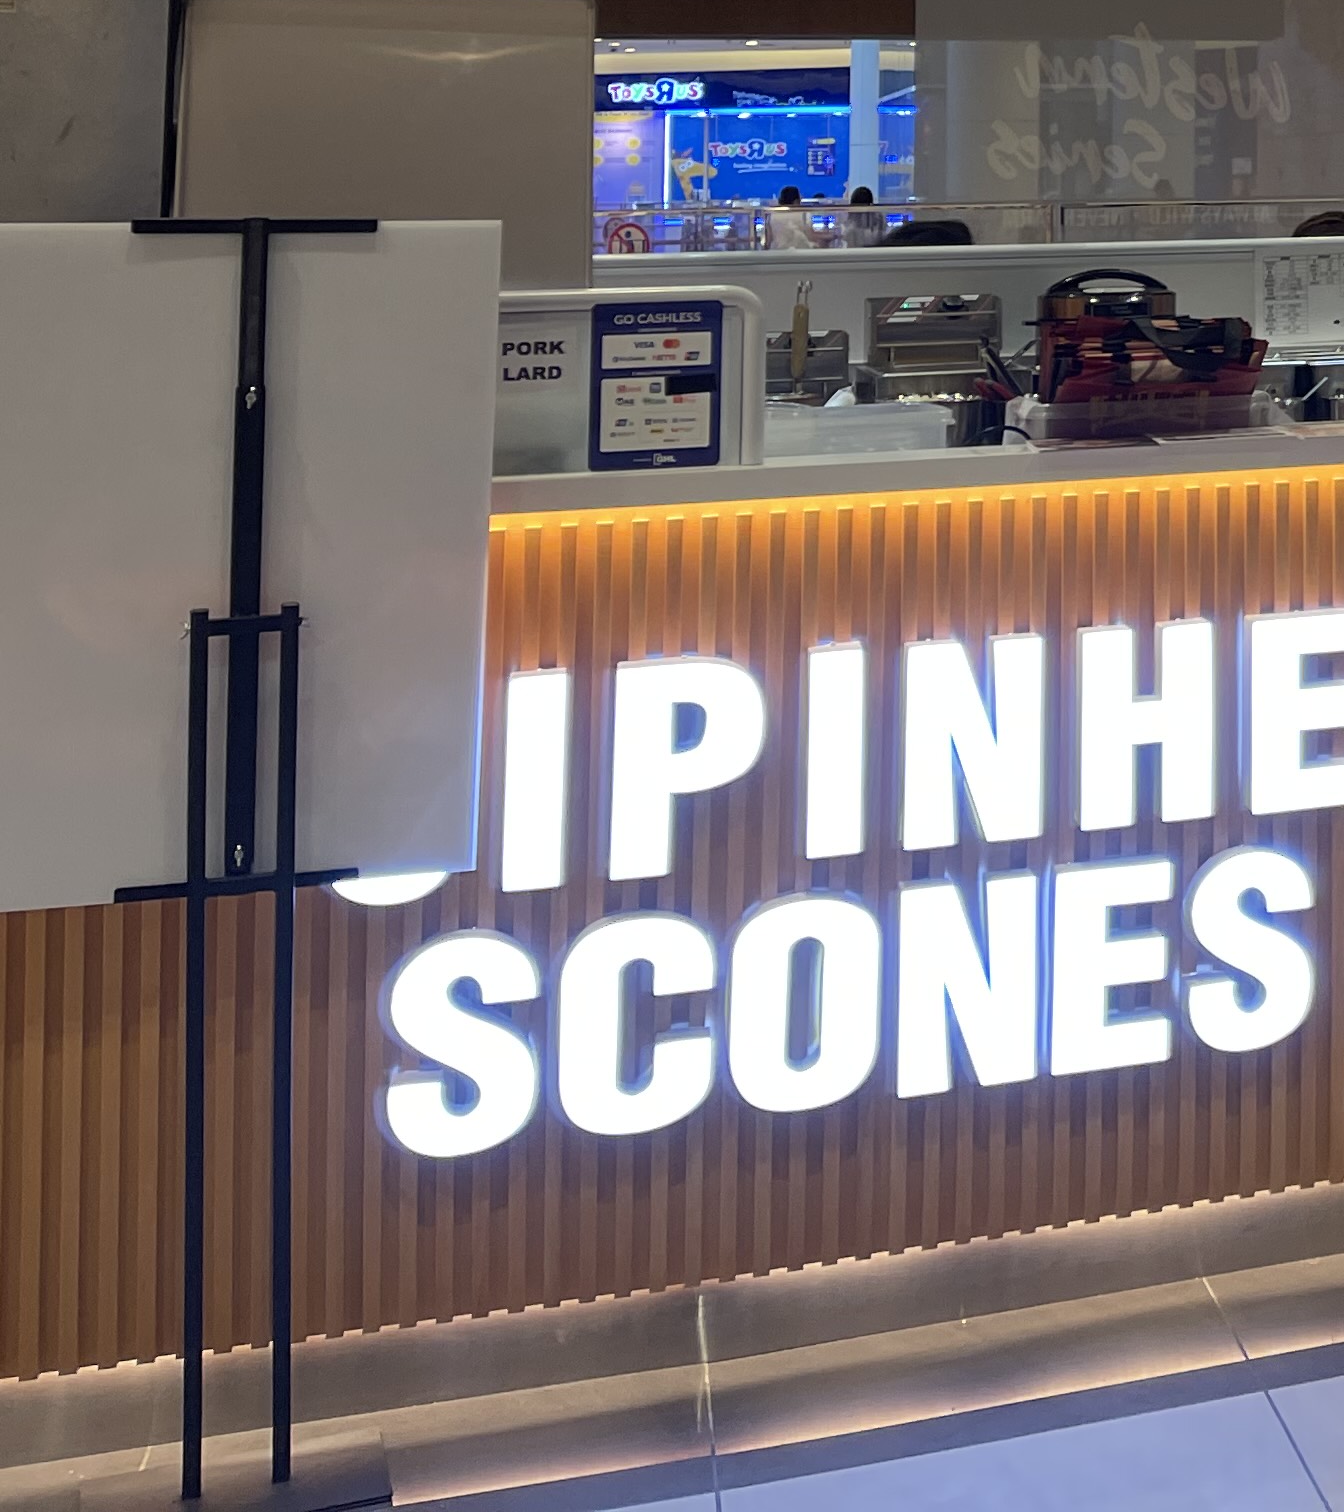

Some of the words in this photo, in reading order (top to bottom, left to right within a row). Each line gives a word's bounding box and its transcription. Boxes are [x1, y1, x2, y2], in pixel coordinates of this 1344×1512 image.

[613, 313, 634, 325] GO
[637, 312, 702, 324] CASHLESS
[501, 340, 565, 356] PORK
[502, 365, 562, 381] LARD
[384, 845, 1317, 1159] SCONES
